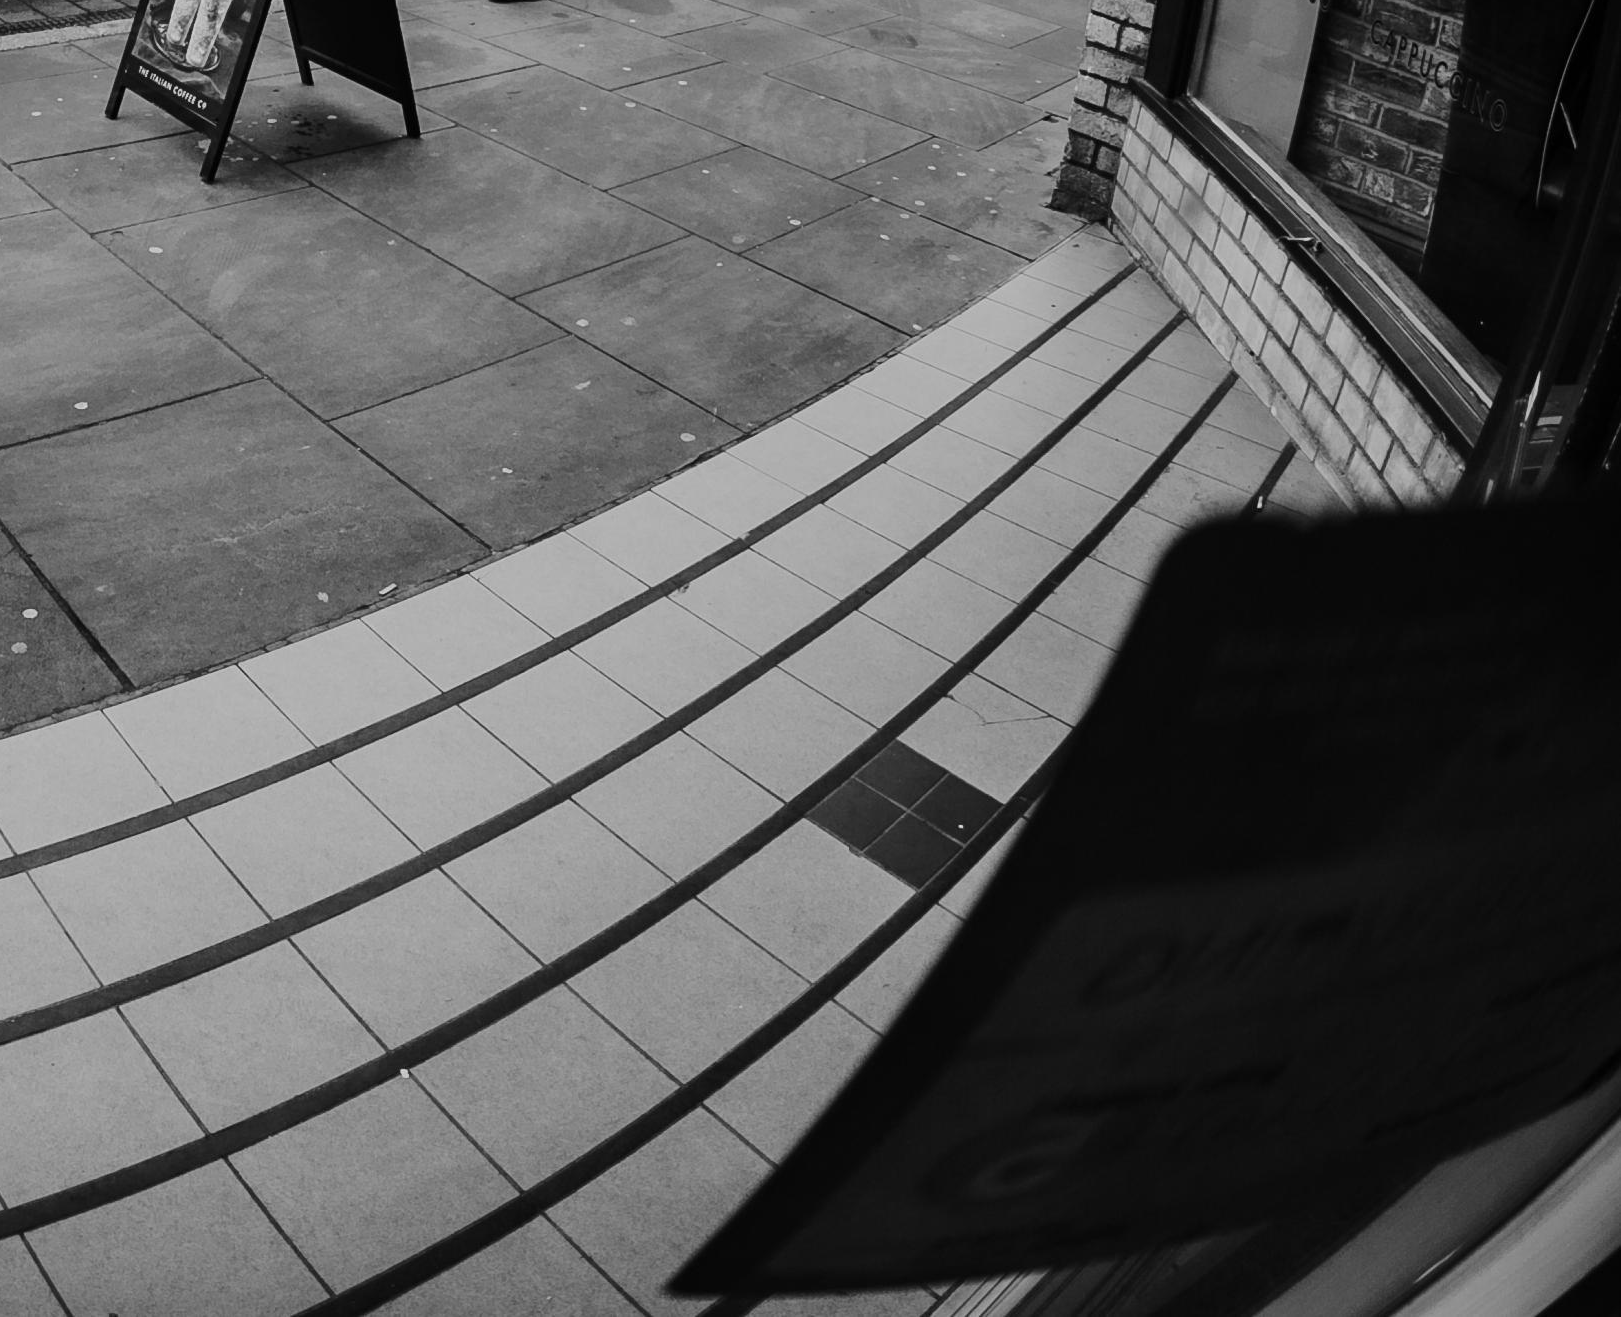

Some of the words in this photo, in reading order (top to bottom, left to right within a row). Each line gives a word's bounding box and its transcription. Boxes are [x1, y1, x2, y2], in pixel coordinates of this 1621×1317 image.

[138, 65, 150, 78] THE
[149, 72, 173, 91] ITALIAN
[173, 85, 197, 105] COFFEE
[1370, 19, 1508, 132] CAPPUCCINO
